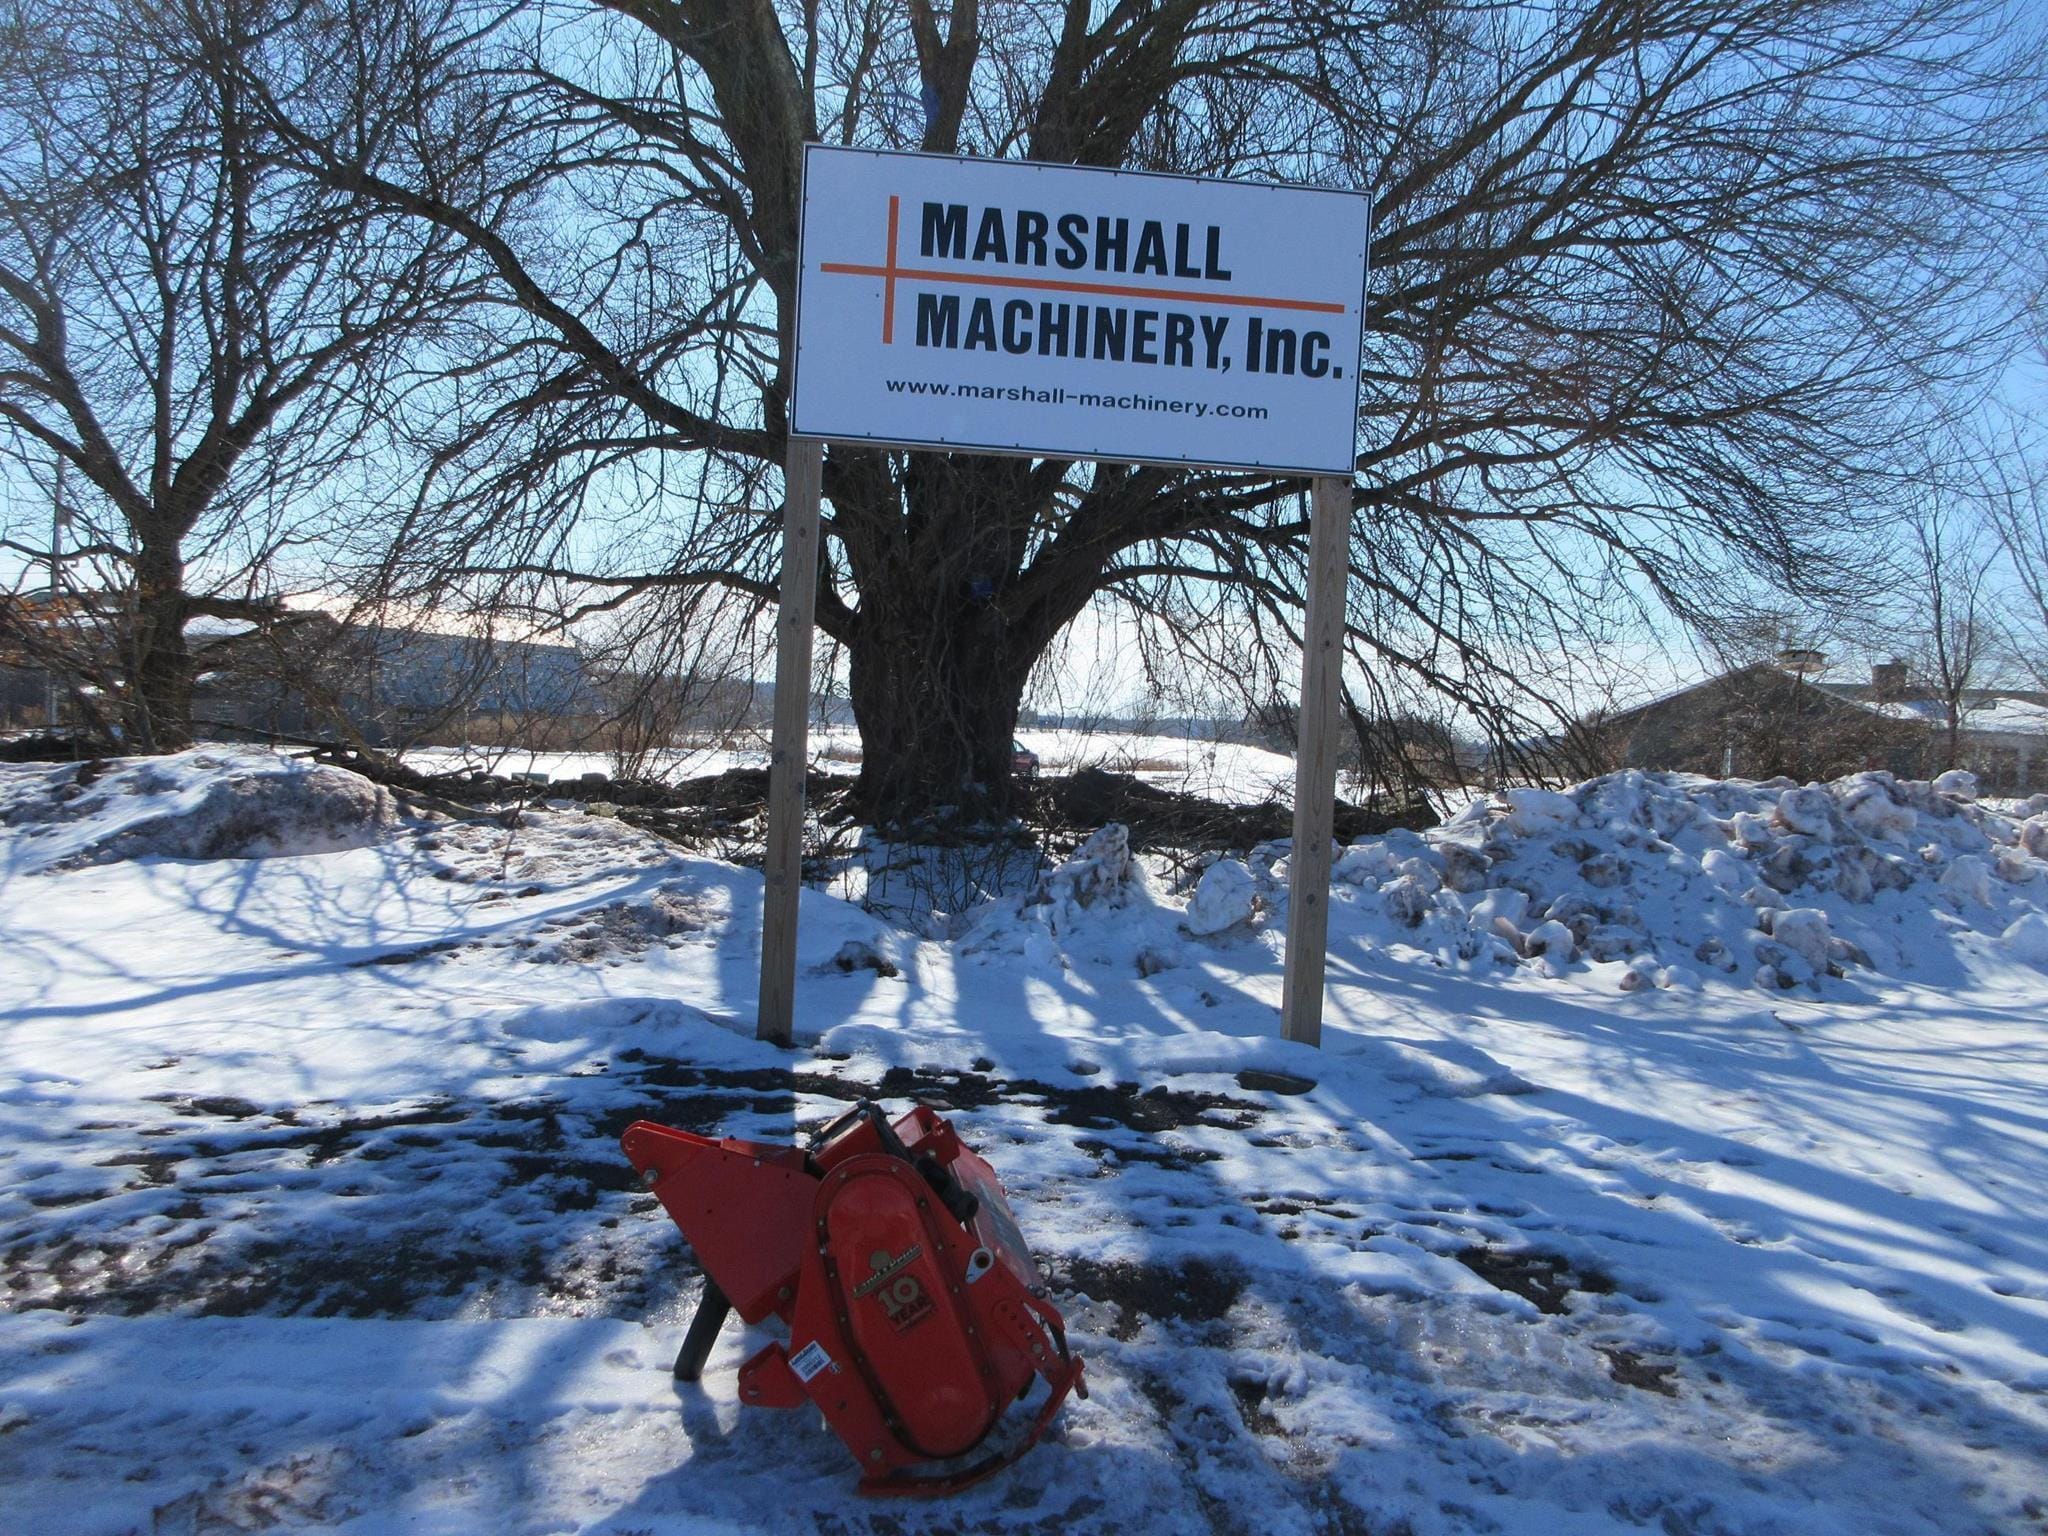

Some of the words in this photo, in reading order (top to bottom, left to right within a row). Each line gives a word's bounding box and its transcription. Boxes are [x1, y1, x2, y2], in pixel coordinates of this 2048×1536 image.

[921, 202, 1232, 281] MARSHALL
[916, 293, 1231, 374] MACHINERY,
[1246, 318, 1344, 379] Inc.
[886, 378, 1269, 419] www.marshall-machinery.com
[879, 1276, 919, 1317] 10
